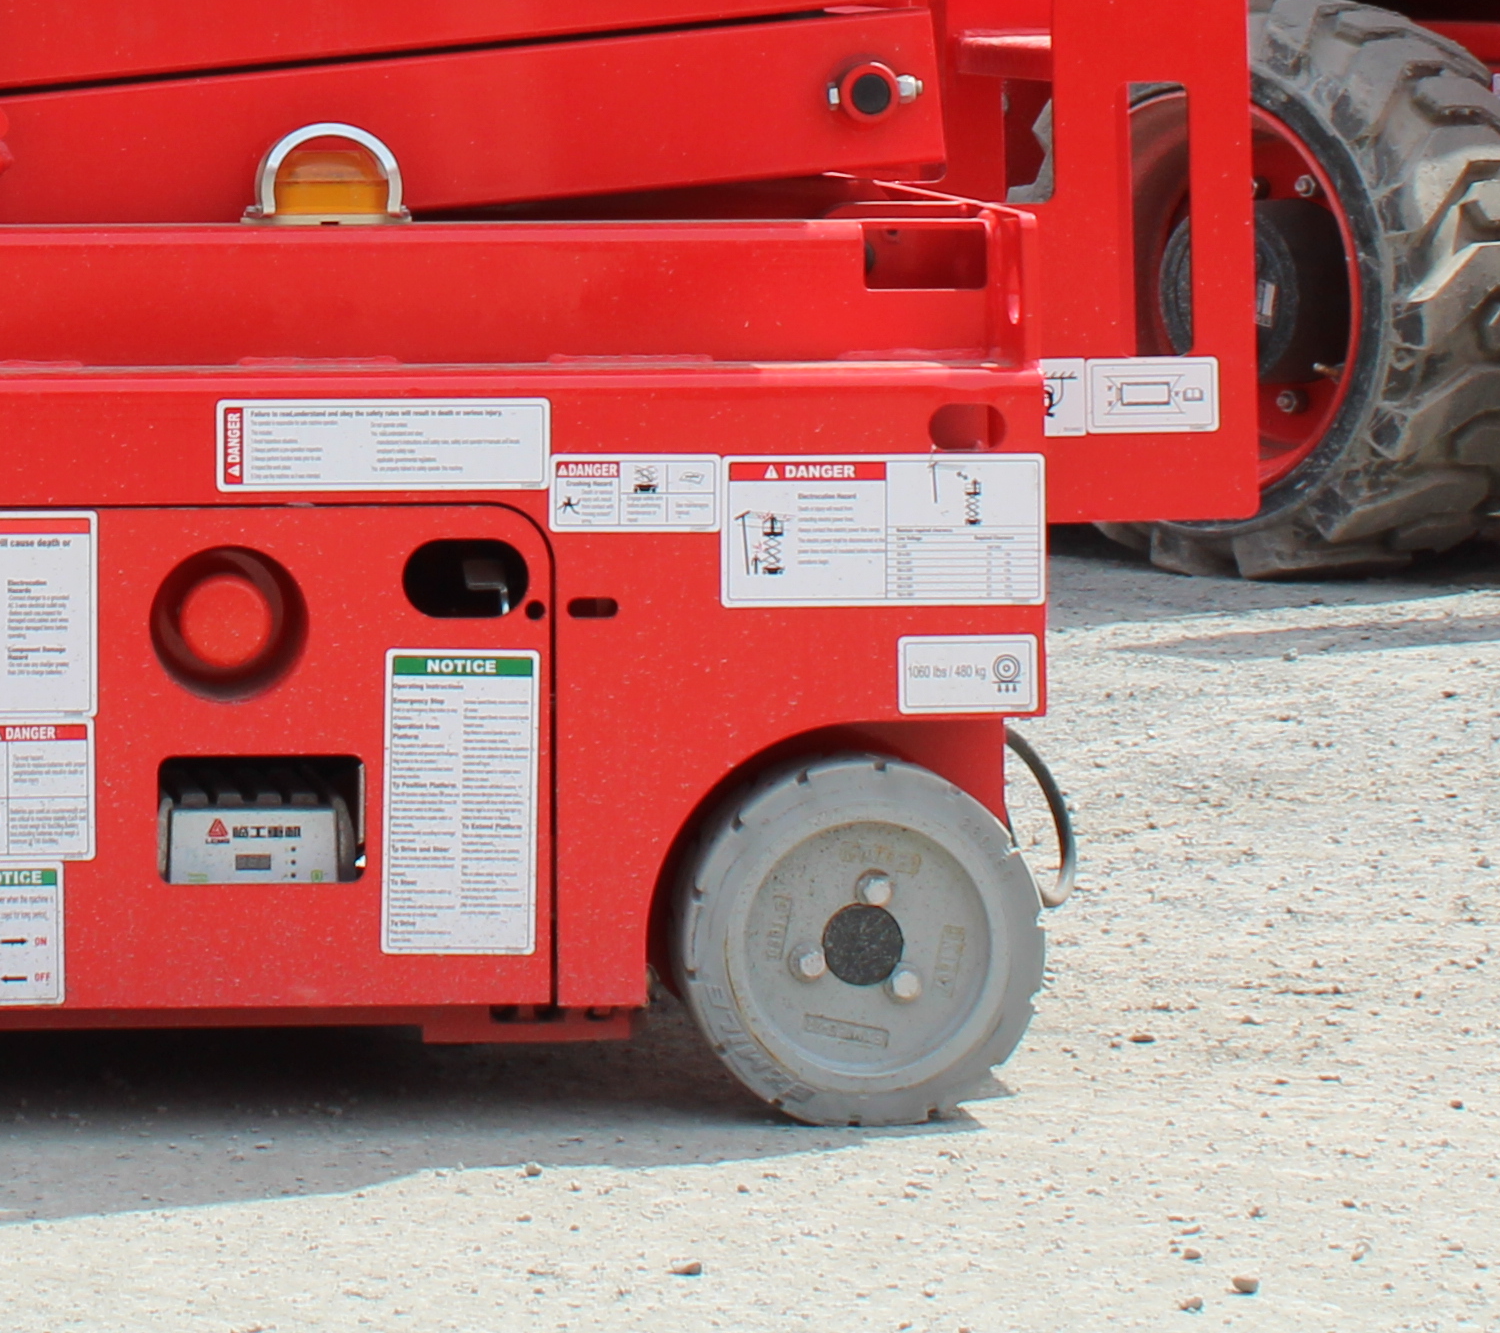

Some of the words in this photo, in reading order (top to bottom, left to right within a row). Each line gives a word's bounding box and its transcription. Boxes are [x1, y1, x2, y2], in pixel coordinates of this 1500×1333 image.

[340, 410, 353, 418] obey
[367, 410, 383, 418] safety
[485, 410, 502, 418] injury.
[227, 413, 241, 463] DANGER
[569, 464, 618, 476] DANGER
[785, 465, 855, 478] DANGER
[37, 539, 60, 547] death
[426, 659, 496, 673] NOTICE
[909, 666, 930, 678] 1060
[933, 665, 947, 678] lbs
[950, 665, 952, 678] /
[954, 665, 971, 677] 480
[975, 665, 986, 680] kg
[5, 727, 56, 740] DANGER
[34, 937, 47, 945] ON
[34, 973, 50, 981] OFF
